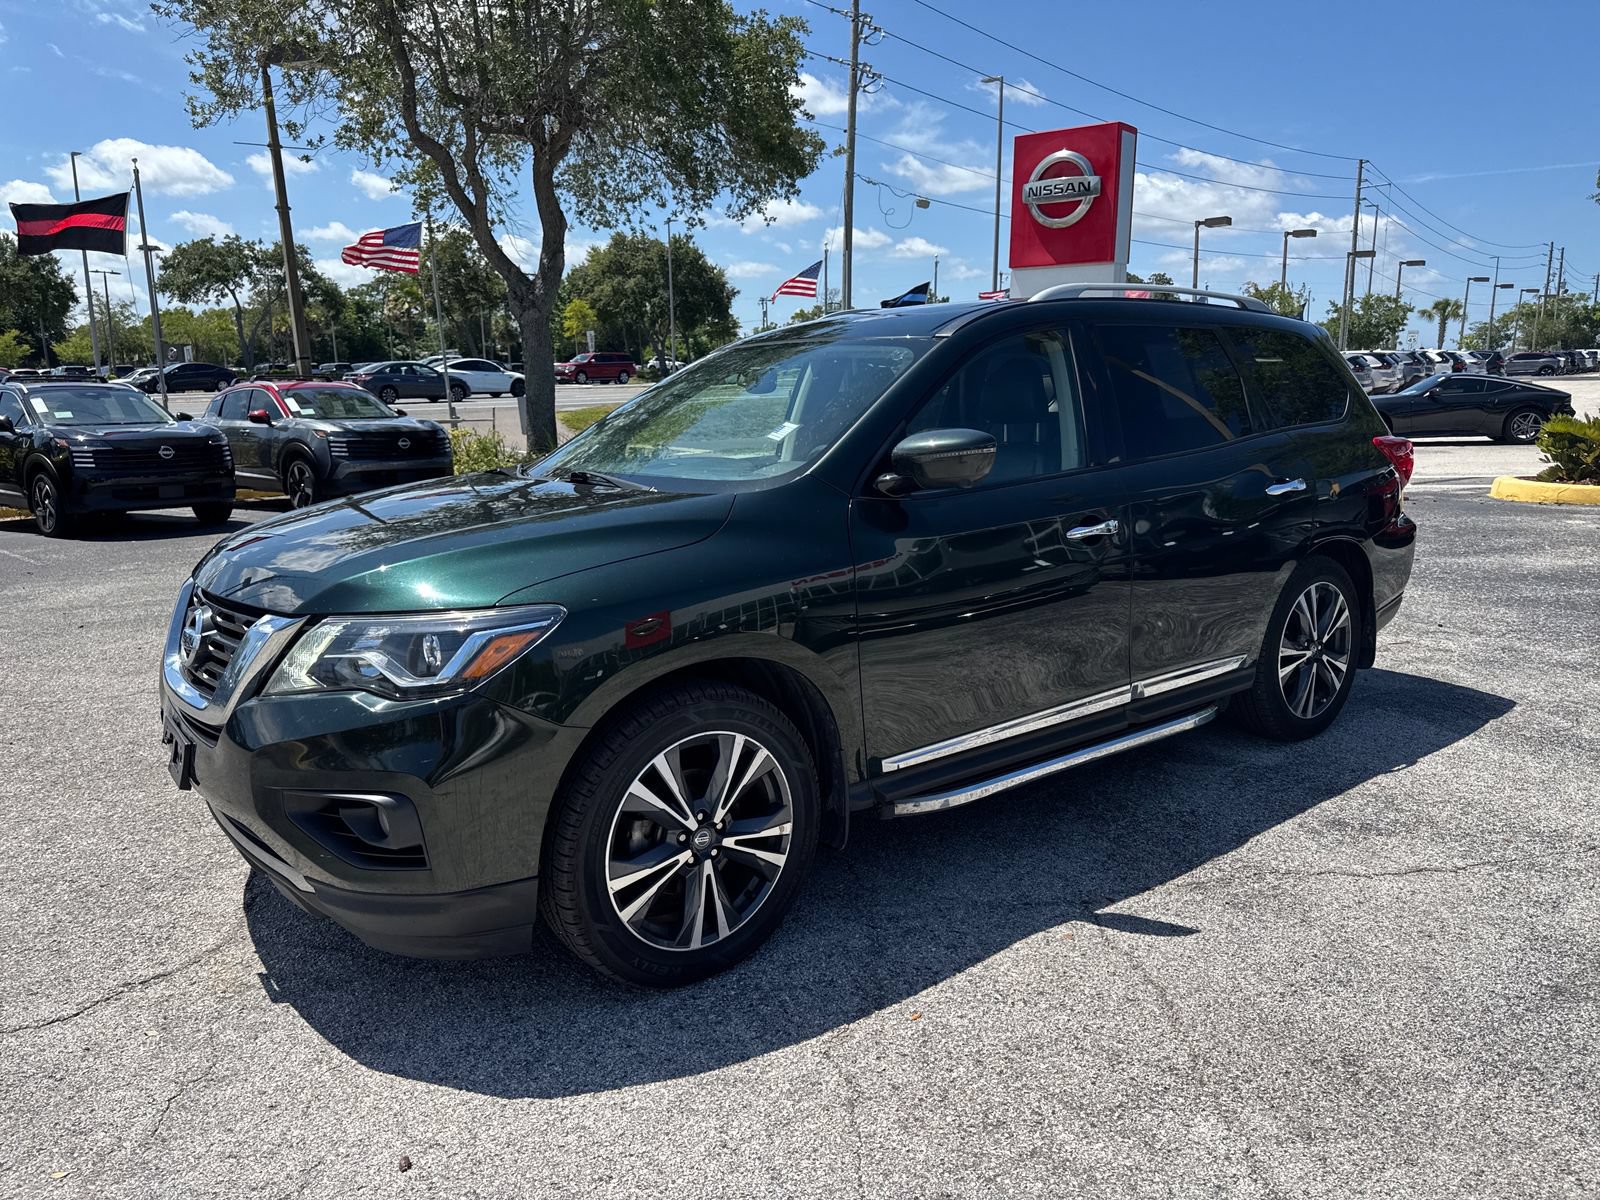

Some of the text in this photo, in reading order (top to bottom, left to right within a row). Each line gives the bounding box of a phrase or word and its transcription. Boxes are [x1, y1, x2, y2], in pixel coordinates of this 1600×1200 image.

[1027, 180, 1092, 199] NISSAN
[735, 709, 780, 734] KELLY
[632, 955, 682, 976] KELLY
